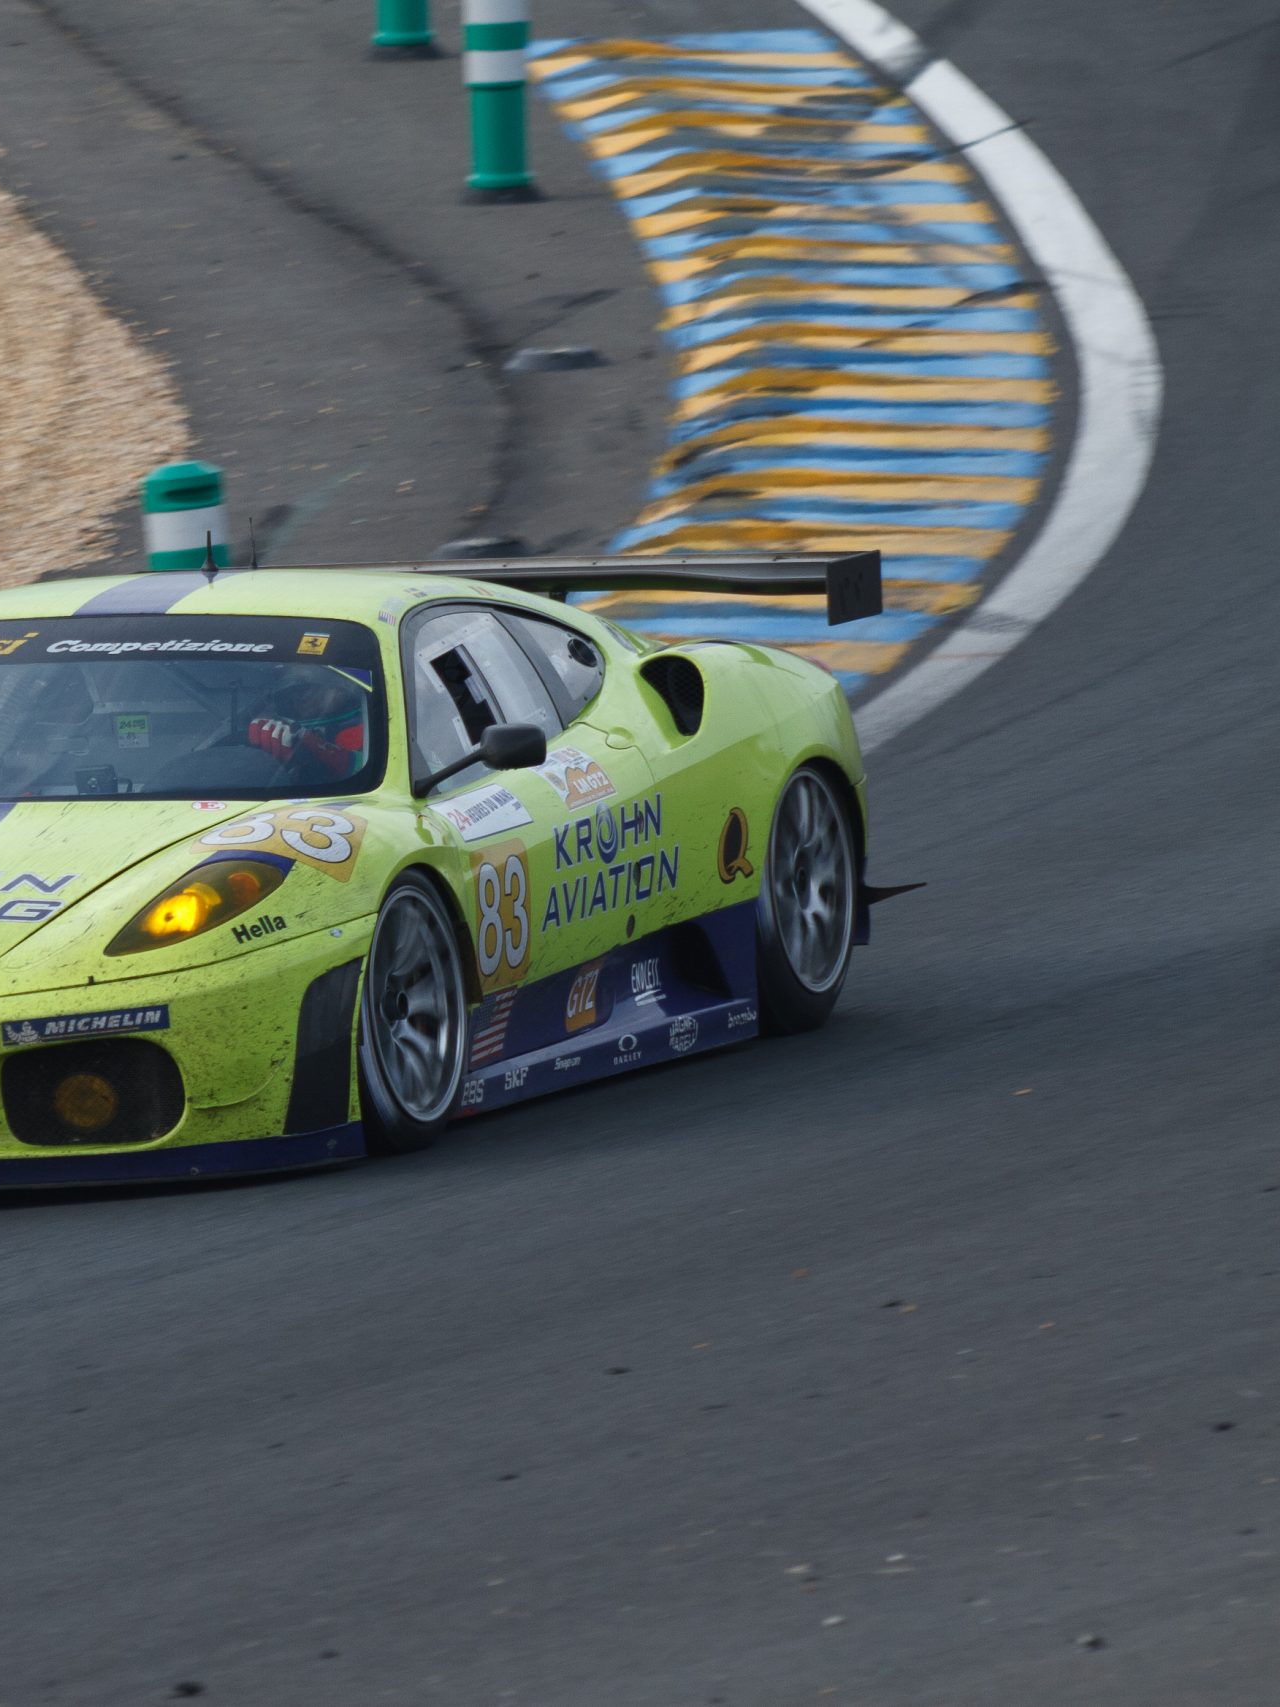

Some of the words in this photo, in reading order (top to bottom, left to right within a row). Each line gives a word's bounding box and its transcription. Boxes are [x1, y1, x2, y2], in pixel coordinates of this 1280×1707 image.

[46, 639, 274, 655] Competizione
[200, 807, 355, 864] 83
[447, 808, 473, 832] 24
[554, 792, 662, 872] KROHN
[541, 844, 680, 934] AVIATION
[231, 913, 288, 945] Hella
[477, 854, 530, 978] 83
[566, 968, 600, 1020] GT2
[44, 1009, 162, 1036] MICHELIN
[613, 1050, 643, 1066] OAKLEY
[504, 1066, 529, 1091] SKF
